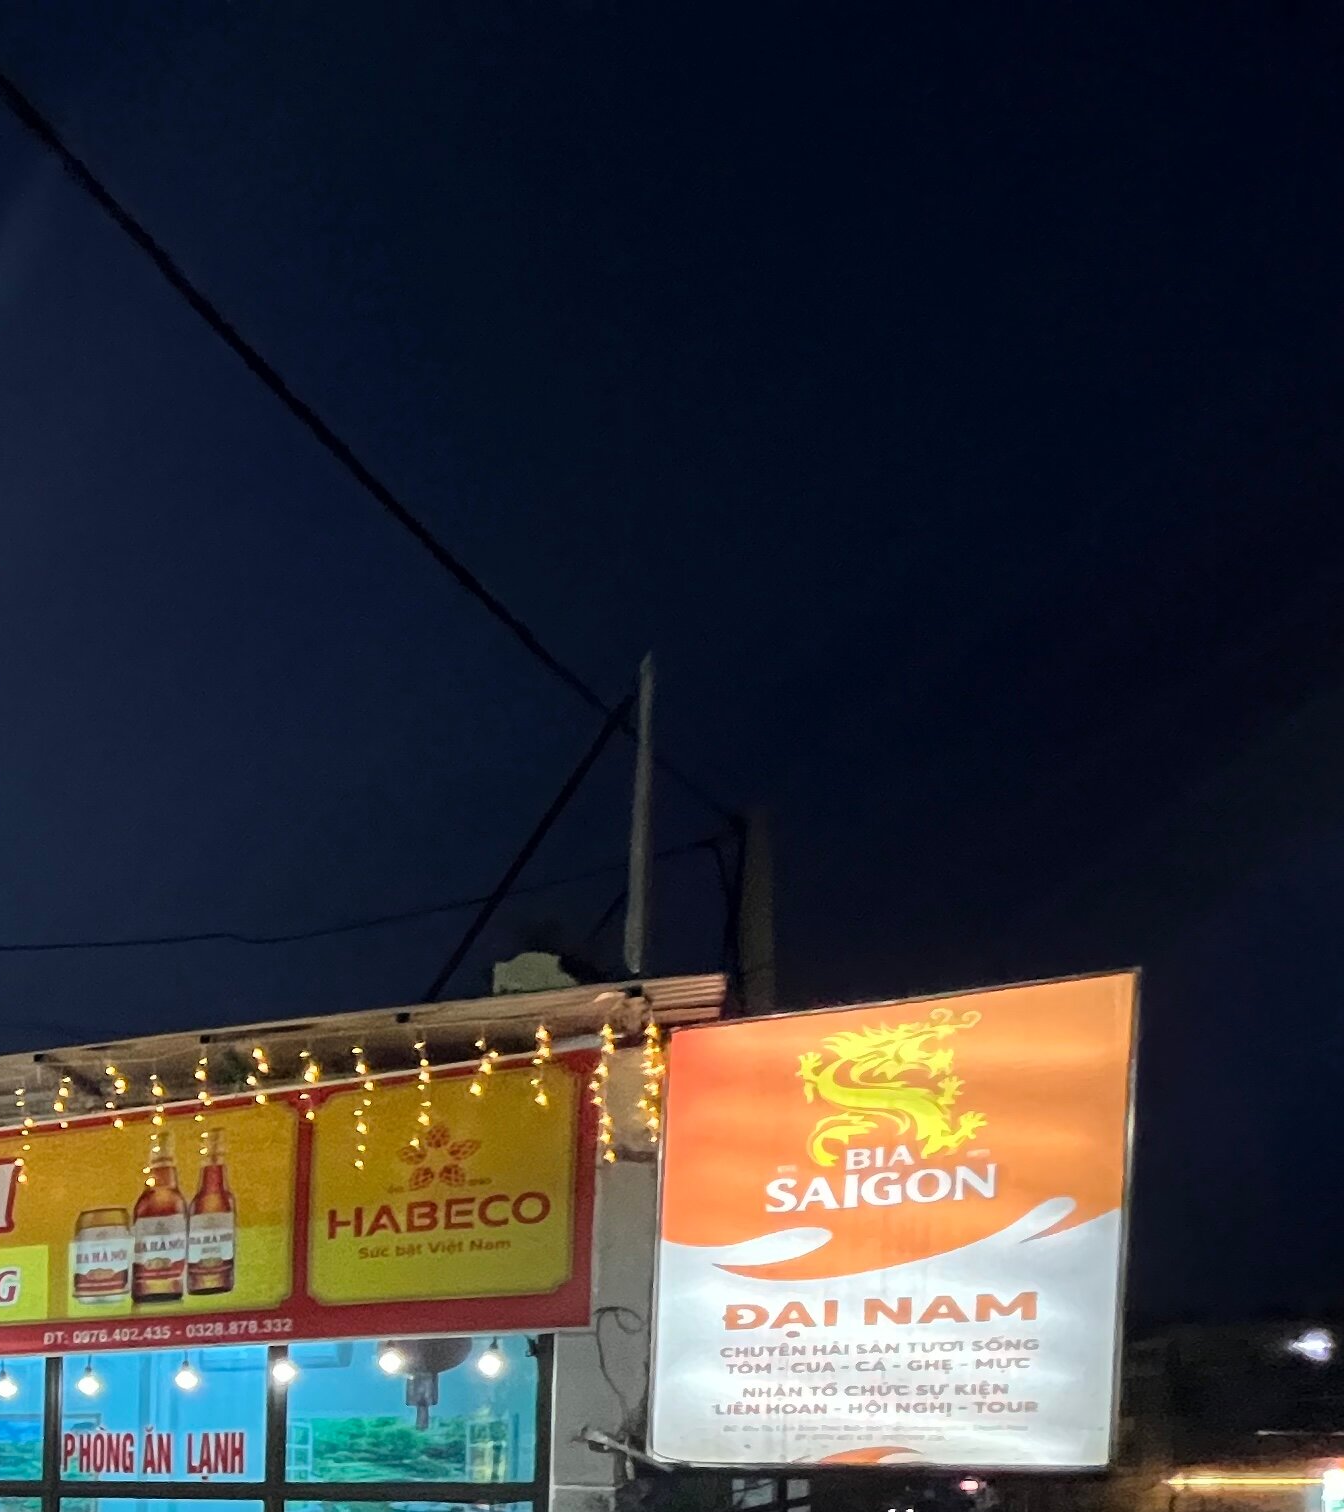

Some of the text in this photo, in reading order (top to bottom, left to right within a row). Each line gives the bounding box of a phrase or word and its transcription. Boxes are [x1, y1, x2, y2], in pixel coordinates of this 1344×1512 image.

[845, 1144, 915, 1171] BIA
[765, 1162, 998, 1213] SAIGON
[327, 1191, 552, 1240] HABECO
[469, 1238, 512, 1252] Nam
[722, 1291, 1039, 1338] ĐẠI NAM
[72, 1325, 172, 1344] 0976.402.435
[720, 1335, 1040, 1359] CHUYÊN HẢI SẢN TƯƠI SỐNG
[726, 1360, 772, 1375] TÔM
[790, 1361, 836, 1374] CUA
[855, 1357, 887, 1372] CÁ
[907, 1358, 953, 1375] GHẸ
[975, 1357, 1031, 1373] MỰC
[844, 1382, 910, 1397] CHỨC
[915, 1383, 949, 1399] SỰ
[954, 1380, 1010, 1399] KIỆN
[714, 1401, 760, 1415] LIÊN
[766, 1403, 828, 1415] HOAN
[848, 1399, 889, 1417] HỘI
[895, 1401, 953, 1418] NGHỊ
[974, 1400, 1039, 1415] TOUR
[63, 1424, 245, 1480] PHÒNG ĂN LẠNH
